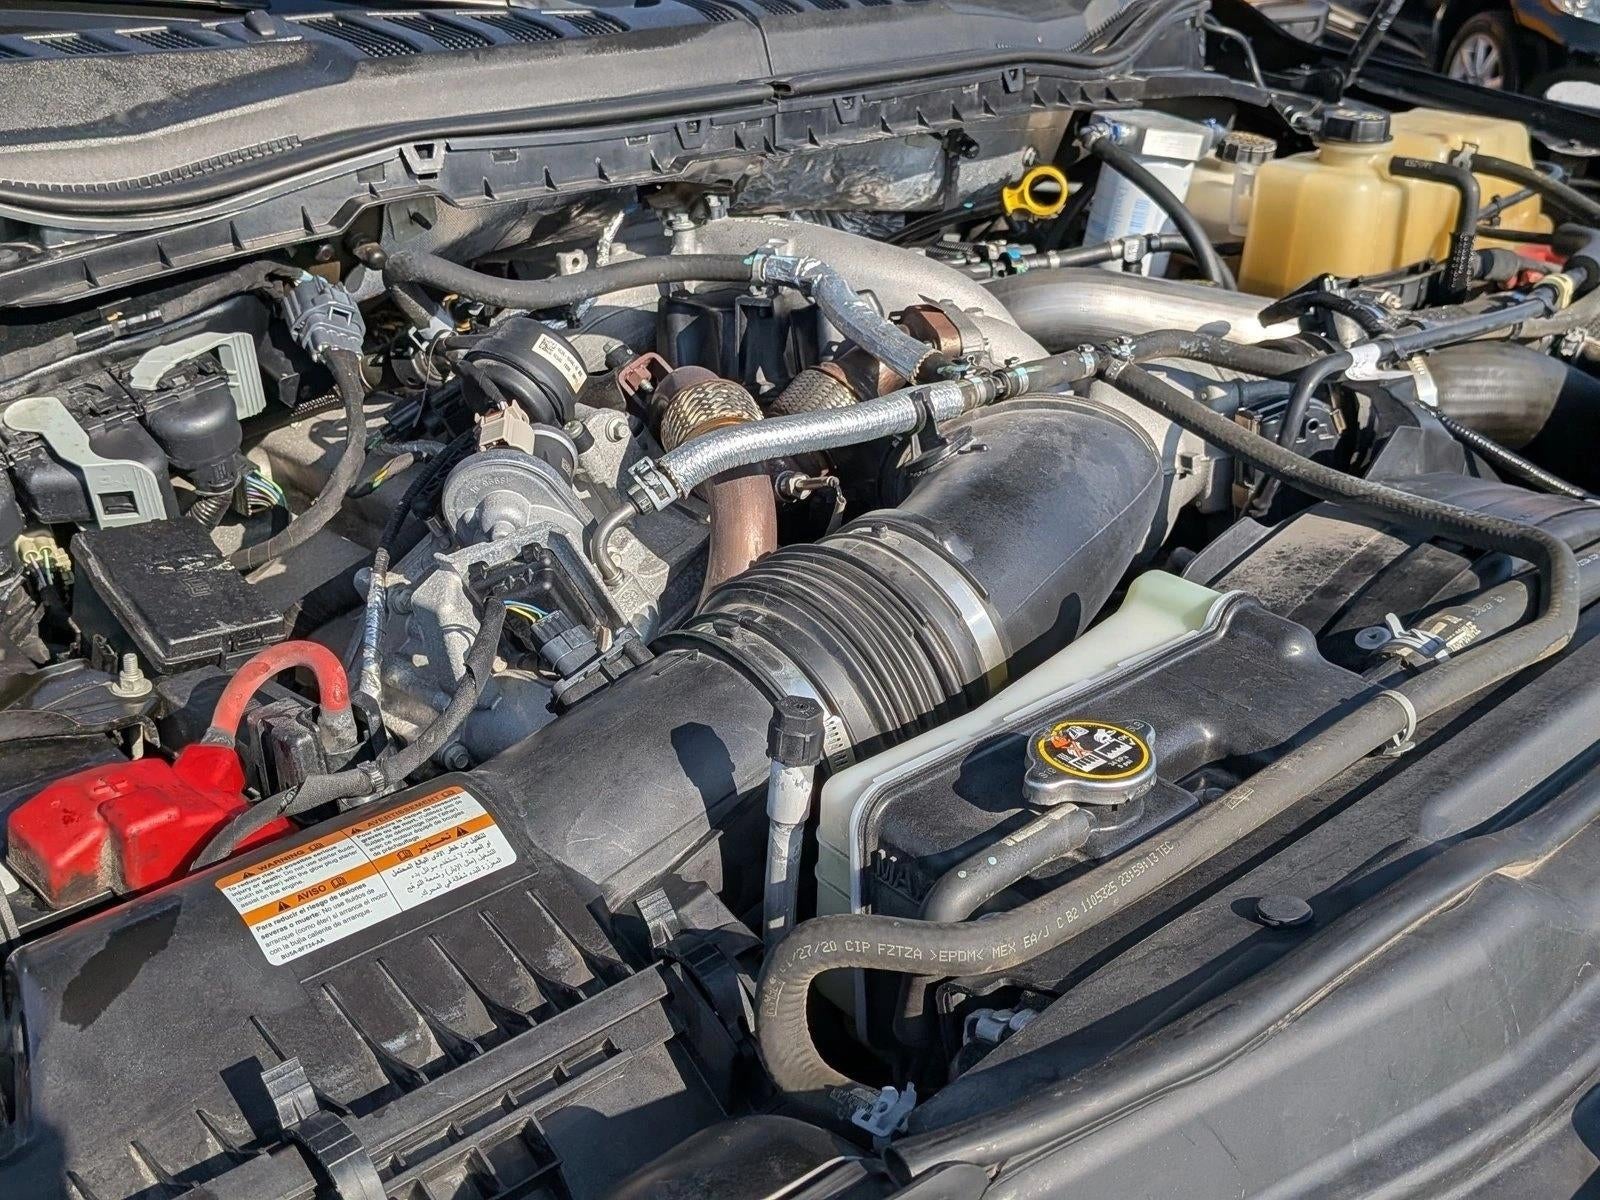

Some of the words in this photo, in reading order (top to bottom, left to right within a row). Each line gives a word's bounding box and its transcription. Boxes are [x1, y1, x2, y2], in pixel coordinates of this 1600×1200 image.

[367, 796, 438, 826] AVERTISSEMENT
[257, 850, 304, 870] WARNING
[255, 922, 272, 931] Para
[273, 911, 297, 924] reducir
[306, 899, 328, 910] riesgo
[338, 883, 366, 897] lesiones
[297, 884, 326, 901] AVISO
[844, 940, 871, 953] CIP
[992, 943, 1017, 959] MEX
[1023, 926, 1050, 948] EA/J
[1065, 907, 1080, 924] B2
[1081, 881, 1118, 913] 1105325
[1117, 853, 1159, 887] 23:59:13
[1159, 840, 1174, 858] TEC
[260, 925, 287, 939] severas
[294, 911, 321, 924] muerte:
[265, 932, 294, 947] arranque
[294, 923, 315, 934] (como
[339, 903, 362, 915] arranca
[370, 891, 387, 902] motor
[269, 947, 282, 955] con
[307, 925, 332, 938] caliente
[342, 909, 372, 923] arranque.
